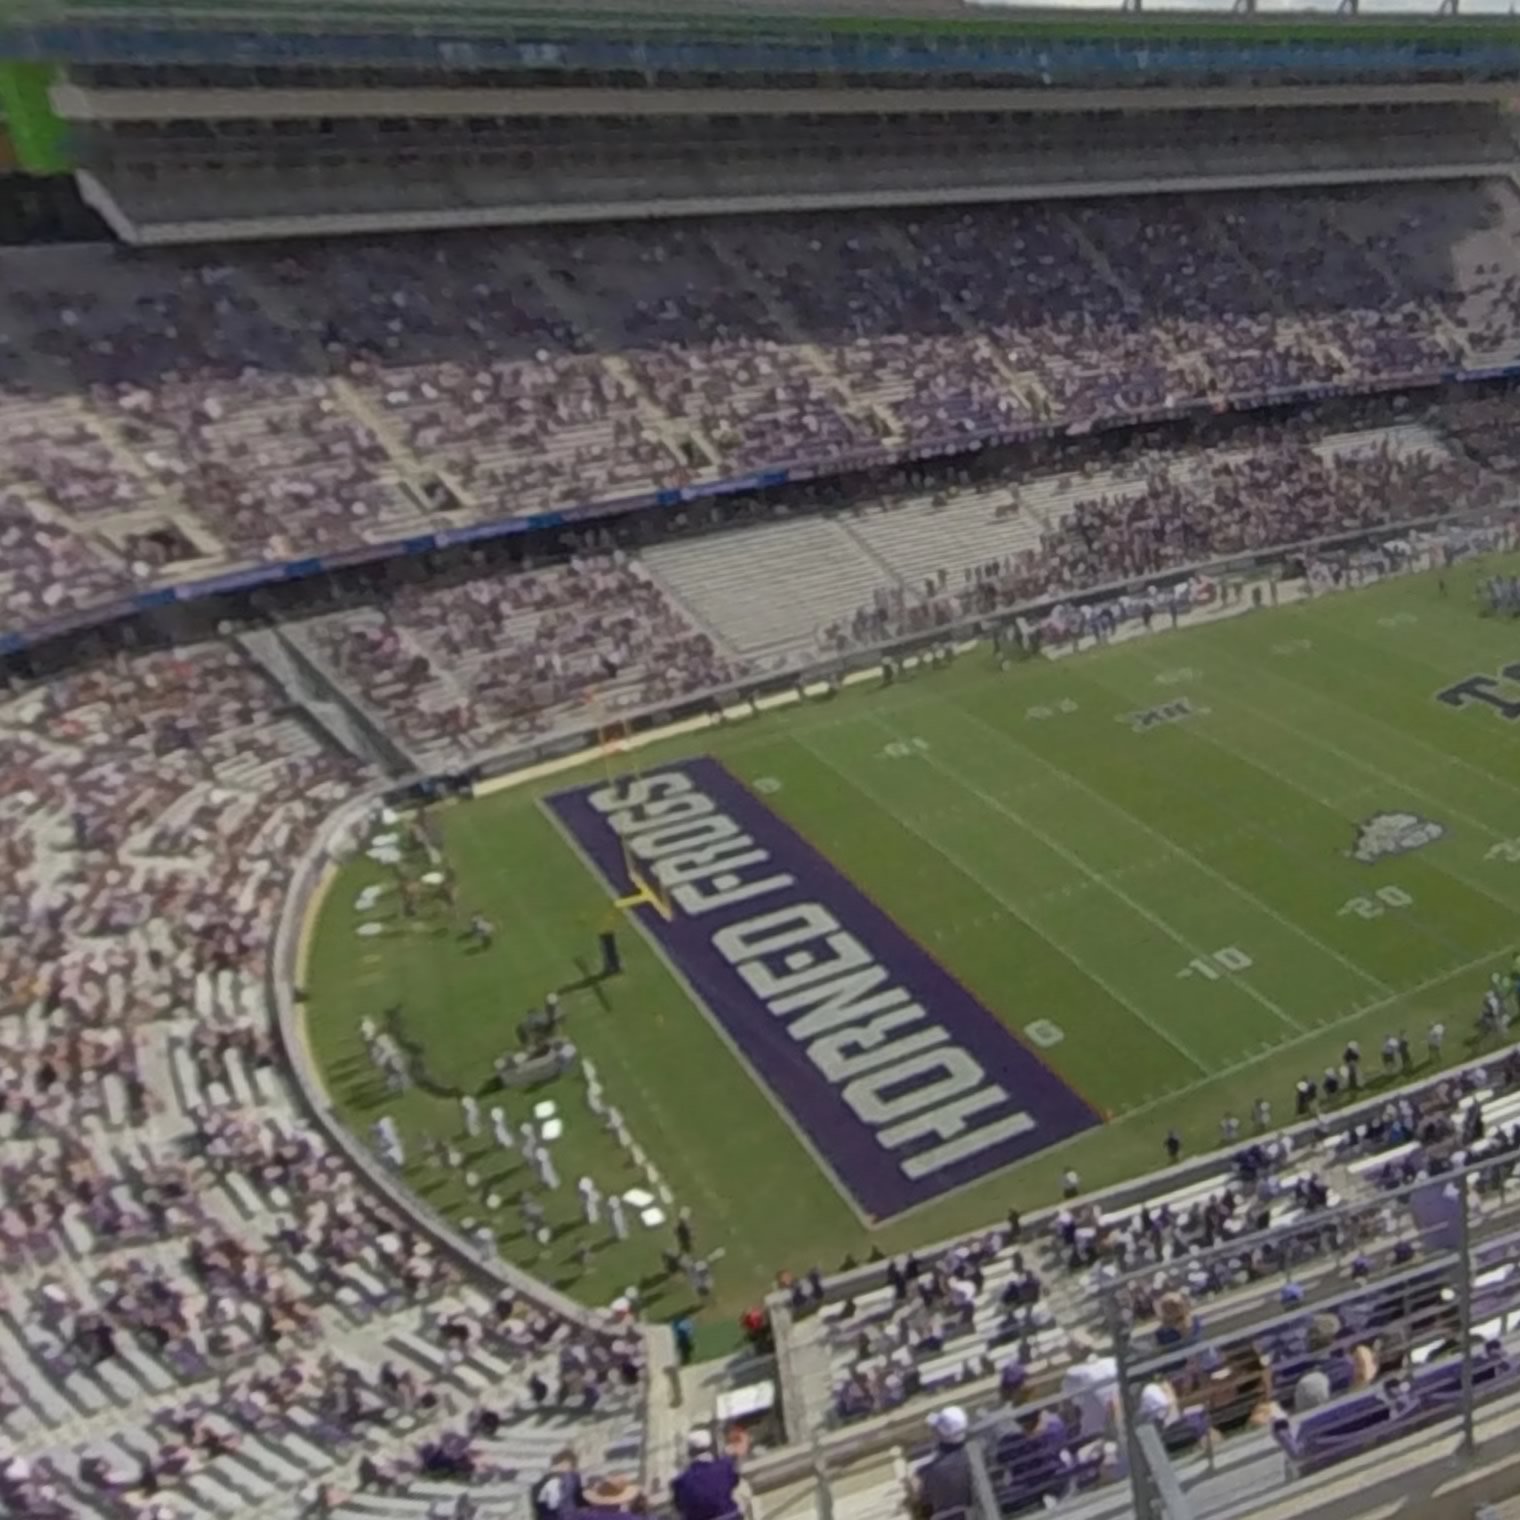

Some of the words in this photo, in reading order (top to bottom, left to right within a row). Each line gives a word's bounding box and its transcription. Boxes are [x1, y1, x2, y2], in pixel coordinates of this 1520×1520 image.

[587, 771, 796, 916] FROGS
[1348, 886, 1412, 919] 20
[1190, 947, 1253, 980] 10
[711, 901, 1037, 1181] HORNED
